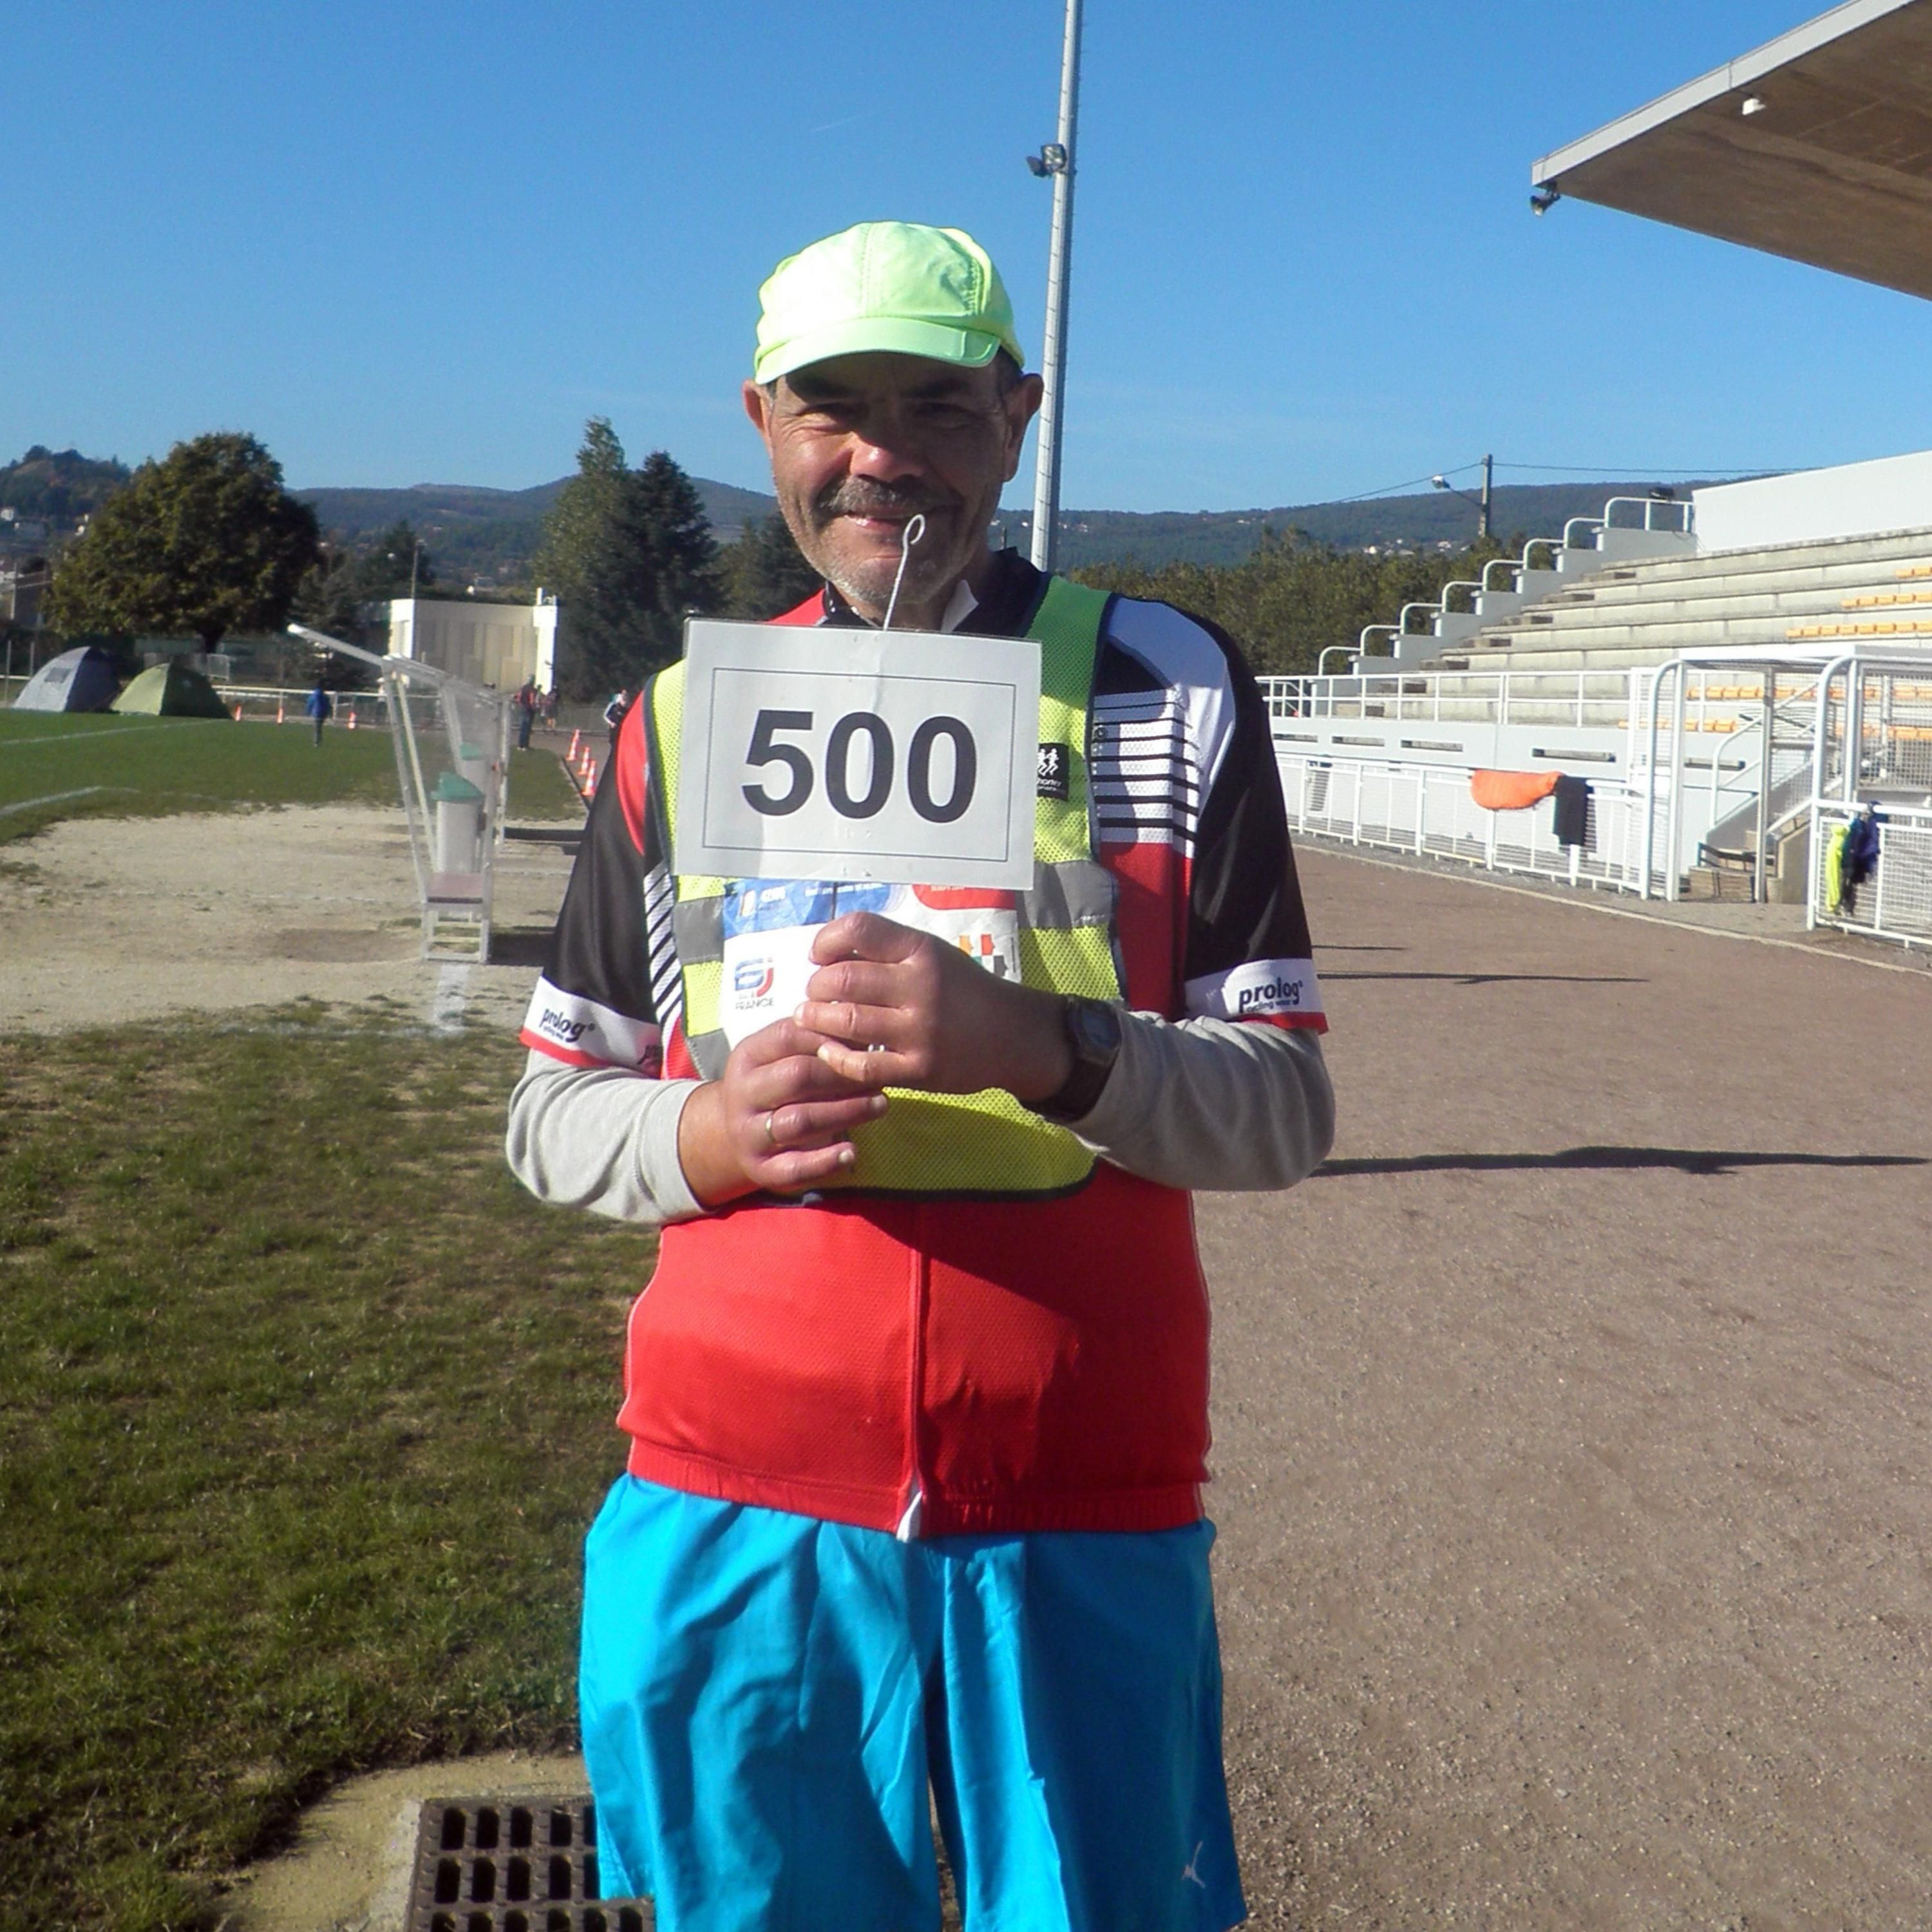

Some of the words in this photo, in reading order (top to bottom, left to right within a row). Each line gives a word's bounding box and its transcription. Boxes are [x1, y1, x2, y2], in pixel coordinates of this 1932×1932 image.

[741, 709, 977, 824] 500
[735, 997, 775, 1011] FRANCE
[1238, 976, 1301, 1014] prolog
[538, 1008, 587, 1043] prolog
